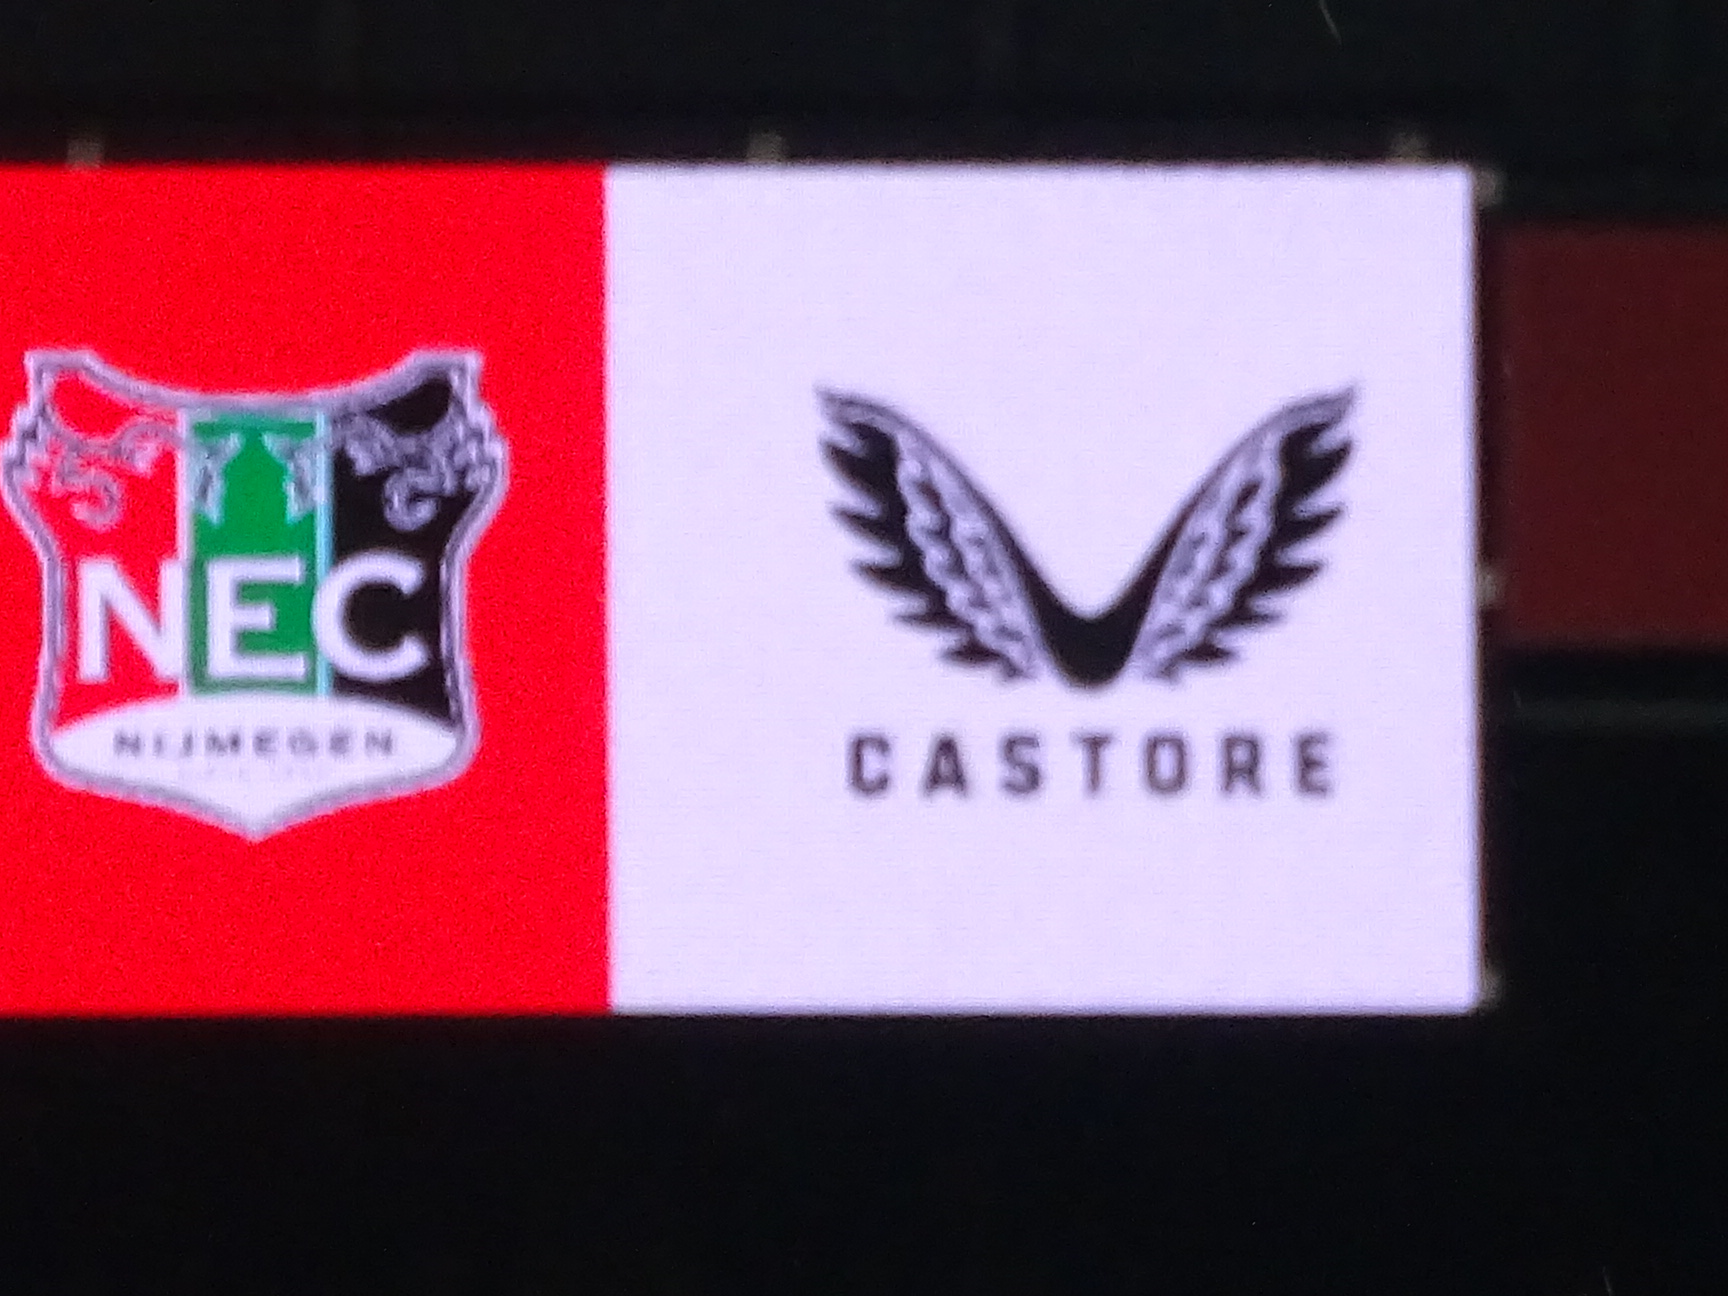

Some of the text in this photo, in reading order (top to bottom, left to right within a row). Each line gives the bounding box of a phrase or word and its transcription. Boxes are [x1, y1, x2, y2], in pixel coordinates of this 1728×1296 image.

[76, 550, 430, 684] NEC
[111, 726, 396, 758] NIJMEGEN
[846, 728, 1334, 800] CASTORE
